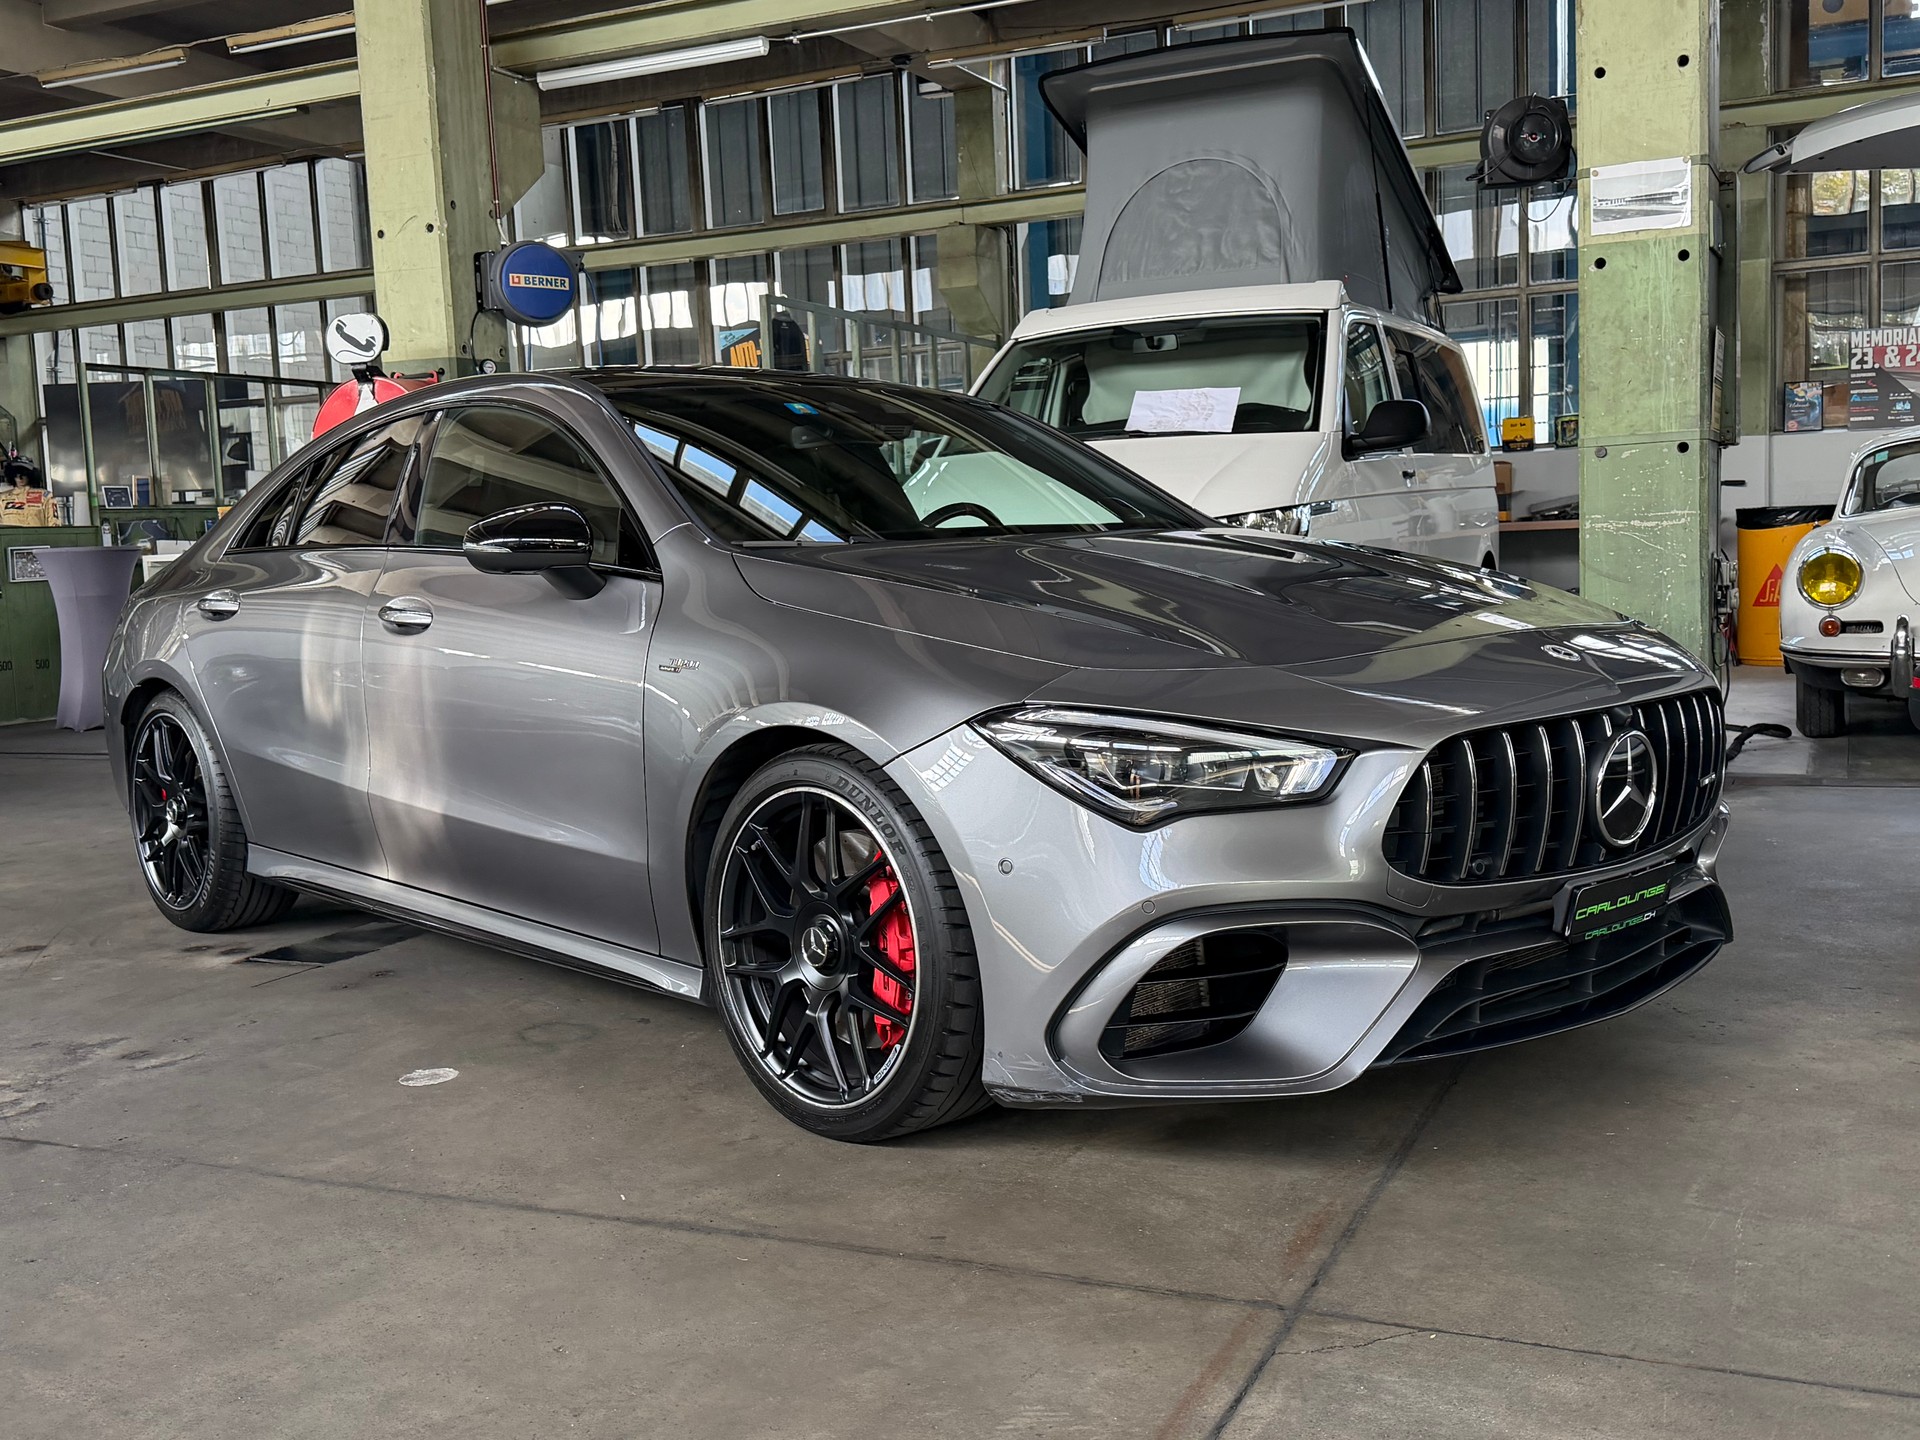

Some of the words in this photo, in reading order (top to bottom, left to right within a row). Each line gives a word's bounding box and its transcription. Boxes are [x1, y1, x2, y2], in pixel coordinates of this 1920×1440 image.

[524, 276, 567, 289] BERNER
[1851, 327, 1920, 348] MEMORIA
[1851, 347, 1880, 370] 23.
[1884, 346, 1901, 368] &
[835, 776, 907, 855] DUNLOP
[200, 848, 216, 908] DUNLOP
[1575, 883, 1667, 920] CARLOUNGE
[1585, 910, 1657, 940] CARLOUNGE.CH
